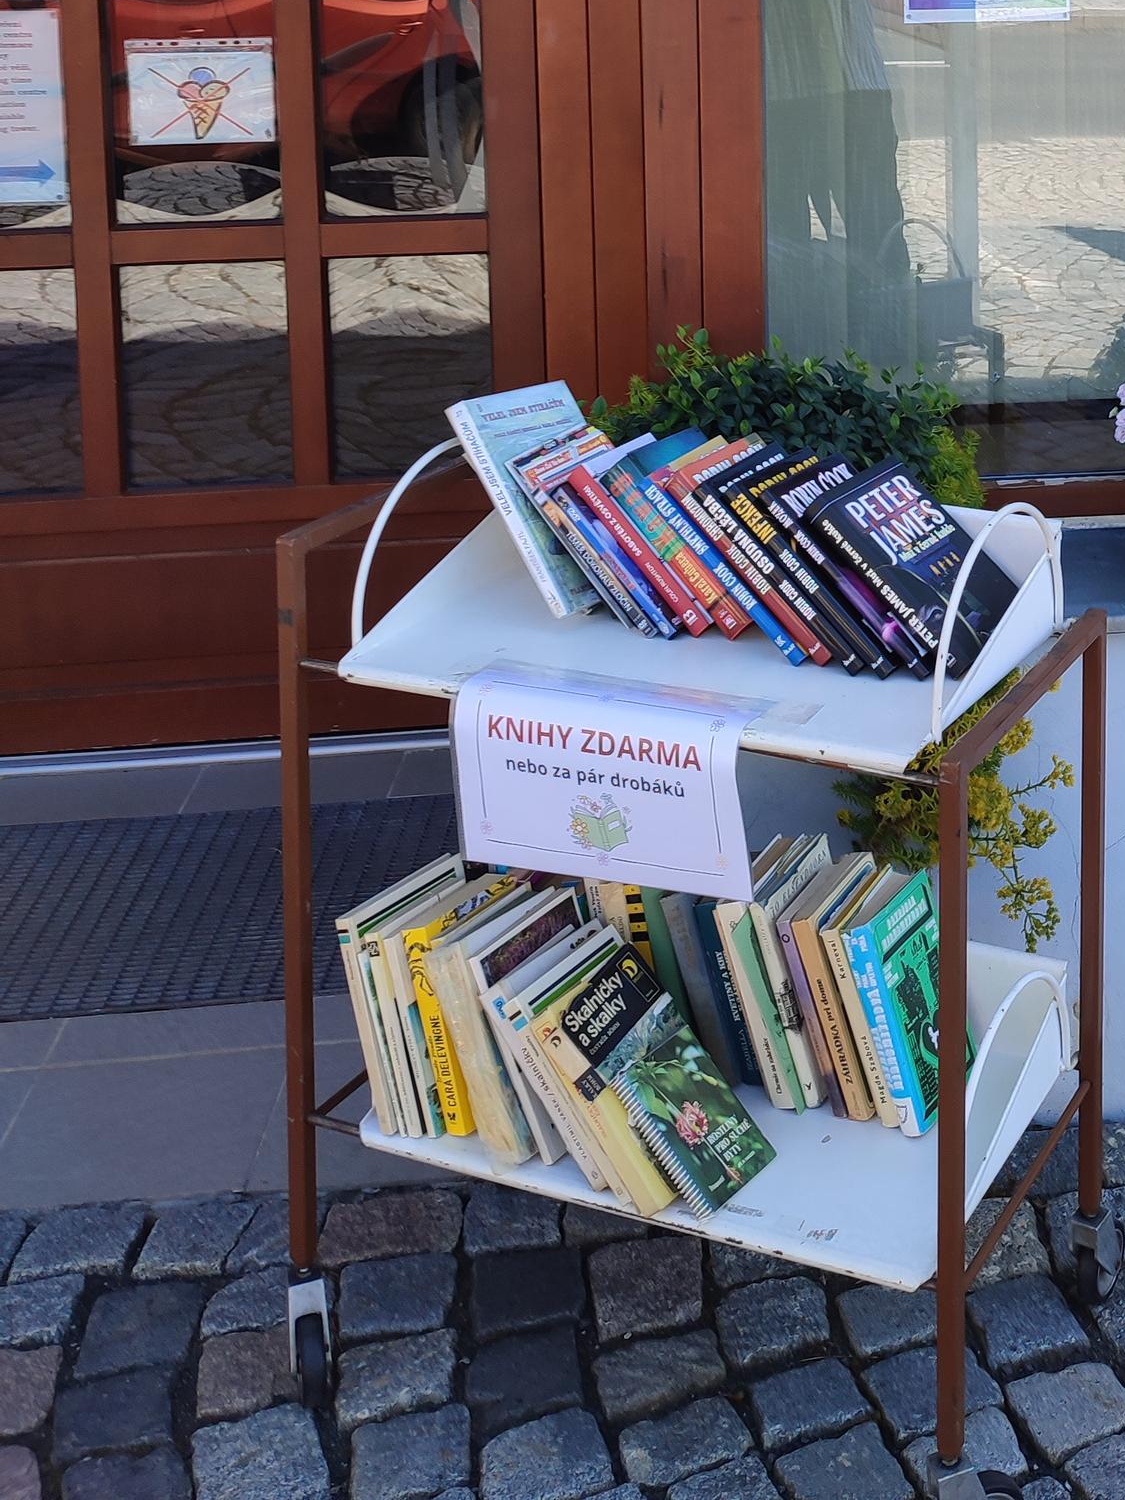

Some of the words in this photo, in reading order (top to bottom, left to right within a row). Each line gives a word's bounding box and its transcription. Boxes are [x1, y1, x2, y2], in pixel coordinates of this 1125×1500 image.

[457, 419, 488, 467] STÍHAČŮM
[481, 463, 500, 490] JSEM
[493, 487, 514, 516] VELEL
[644, 483, 676, 518] STRACH
[698, 492, 739, 535] LÉČBA
[845, 475, 922, 529] PETER
[668, 510, 709, 556] SMRTELNÝ
[728, 491, 778, 545] INFEKCE
[818, 517, 844, 544] kukle
[870, 500, 945, 566] JAMES
[612, 522, 643, 558] SABOTÉR
[730, 527, 776, 576] OSUDNÁ
[791, 528, 812, 550] COOK
[805, 543, 826, 565] ROBIN
[838, 539, 864, 566] černé
[726, 542, 751, 570] COOK
[777, 547, 801, 572] COOK
[693, 575, 719, 605] Karel
[712, 560, 738, 588] COOK
[743, 563, 772, 595] ROBIN
[776, 578, 799, 601] COOK
[794, 566, 820, 594] ROBIN
[863, 566, 884, 588] Muž
[729, 580, 757, 610] ROBIN
[792, 594, 817, 621] ROBIN
[878, 581, 914, 620] JAMES
[906, 613, 939, 649] PETER
[488, 714, 573, 749] KNIHY
[580, 728, 702, 771] ZDARMA
[506, 757, 548, 775] nebo
[552, 766, 571, 779] za
[577, 769, 604, 785] pár
[610, 773, 685, 797] drobáků
[826, 938, 849, 980] Karneval
[563, 971, 624, 1033] Skalničky
[813, 977, 829, 1006] dome
[578, 1034, 592, 1047] a
[588, 993, 627, 1042] skalky
[426, 1013, 453, 1077] DELEVINGNE
[825, 1023, 857, 1086] ZÁHRADKA
[857, 1034, 878, 1072] Szabová
[515, 1045, 553, 1093] skalničky
[441, 1076, 459, 1108] CARA
[871, 1073, 890, 1104] Magda
[707, 1114, 738, 1145] ROSTLINY
[714, 1138, 731, 1153] PRO
[729, 1118, 752, 1140] SUCHÉ
[723, 1141, 743, 1161] BYTY
